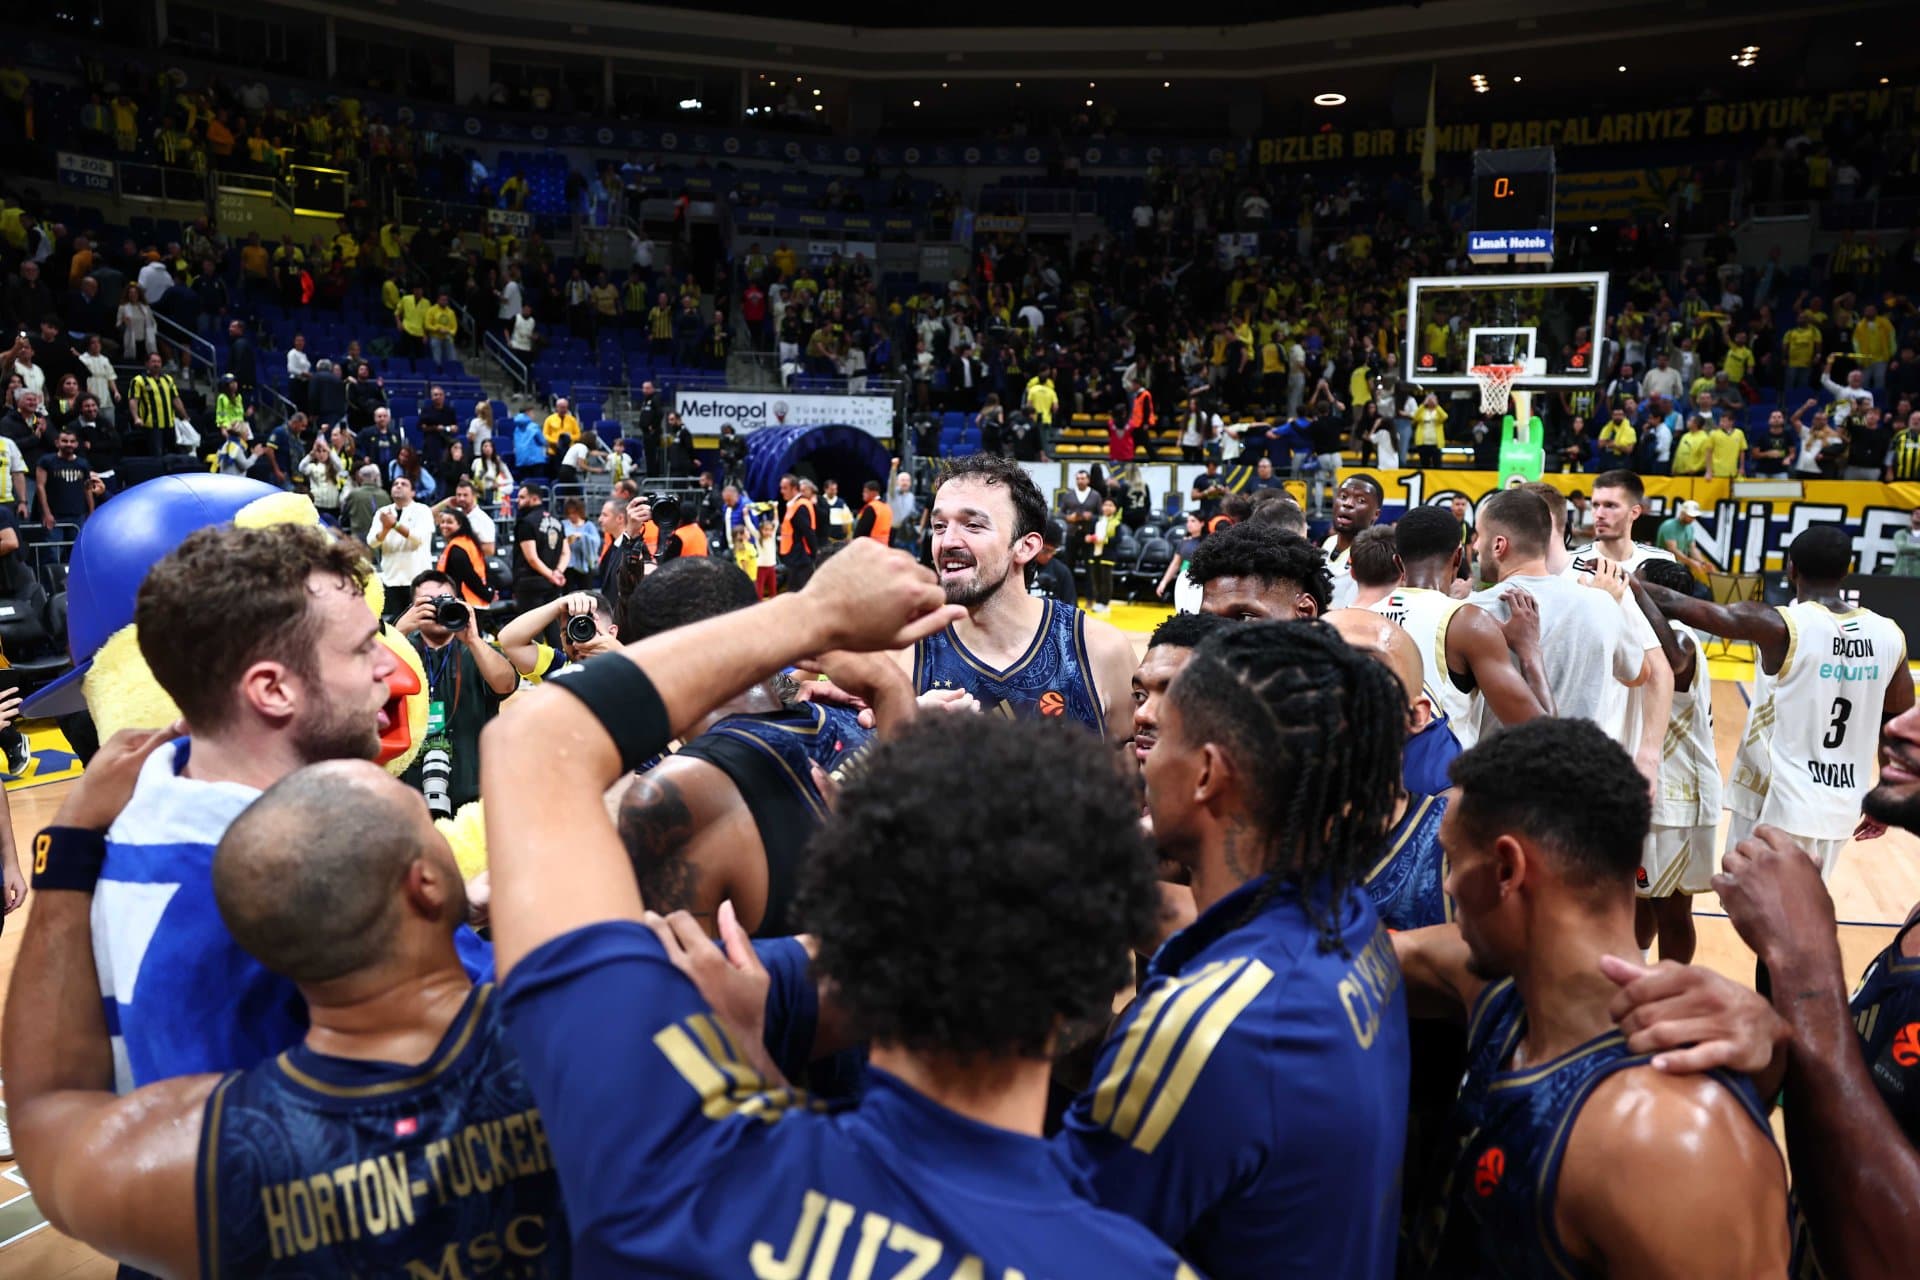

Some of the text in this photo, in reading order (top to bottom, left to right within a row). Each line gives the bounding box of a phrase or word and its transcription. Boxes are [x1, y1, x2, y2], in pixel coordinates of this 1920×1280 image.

[80, 158, 107, 172] 202
[84, 175, 110, 189] 102
[1472, 236, 1546, 250] Limak Hotels
[681, 400, 767, 421] Metropol
[1833, 637, 1875, 658] BACON
[1823, 697, 1853, 749] 3
[35, 833, 53, 875] 8
[261, 1110, 552, 1260] HORTON-TUCKER
[403, 1215, 549, 1280] MSC
